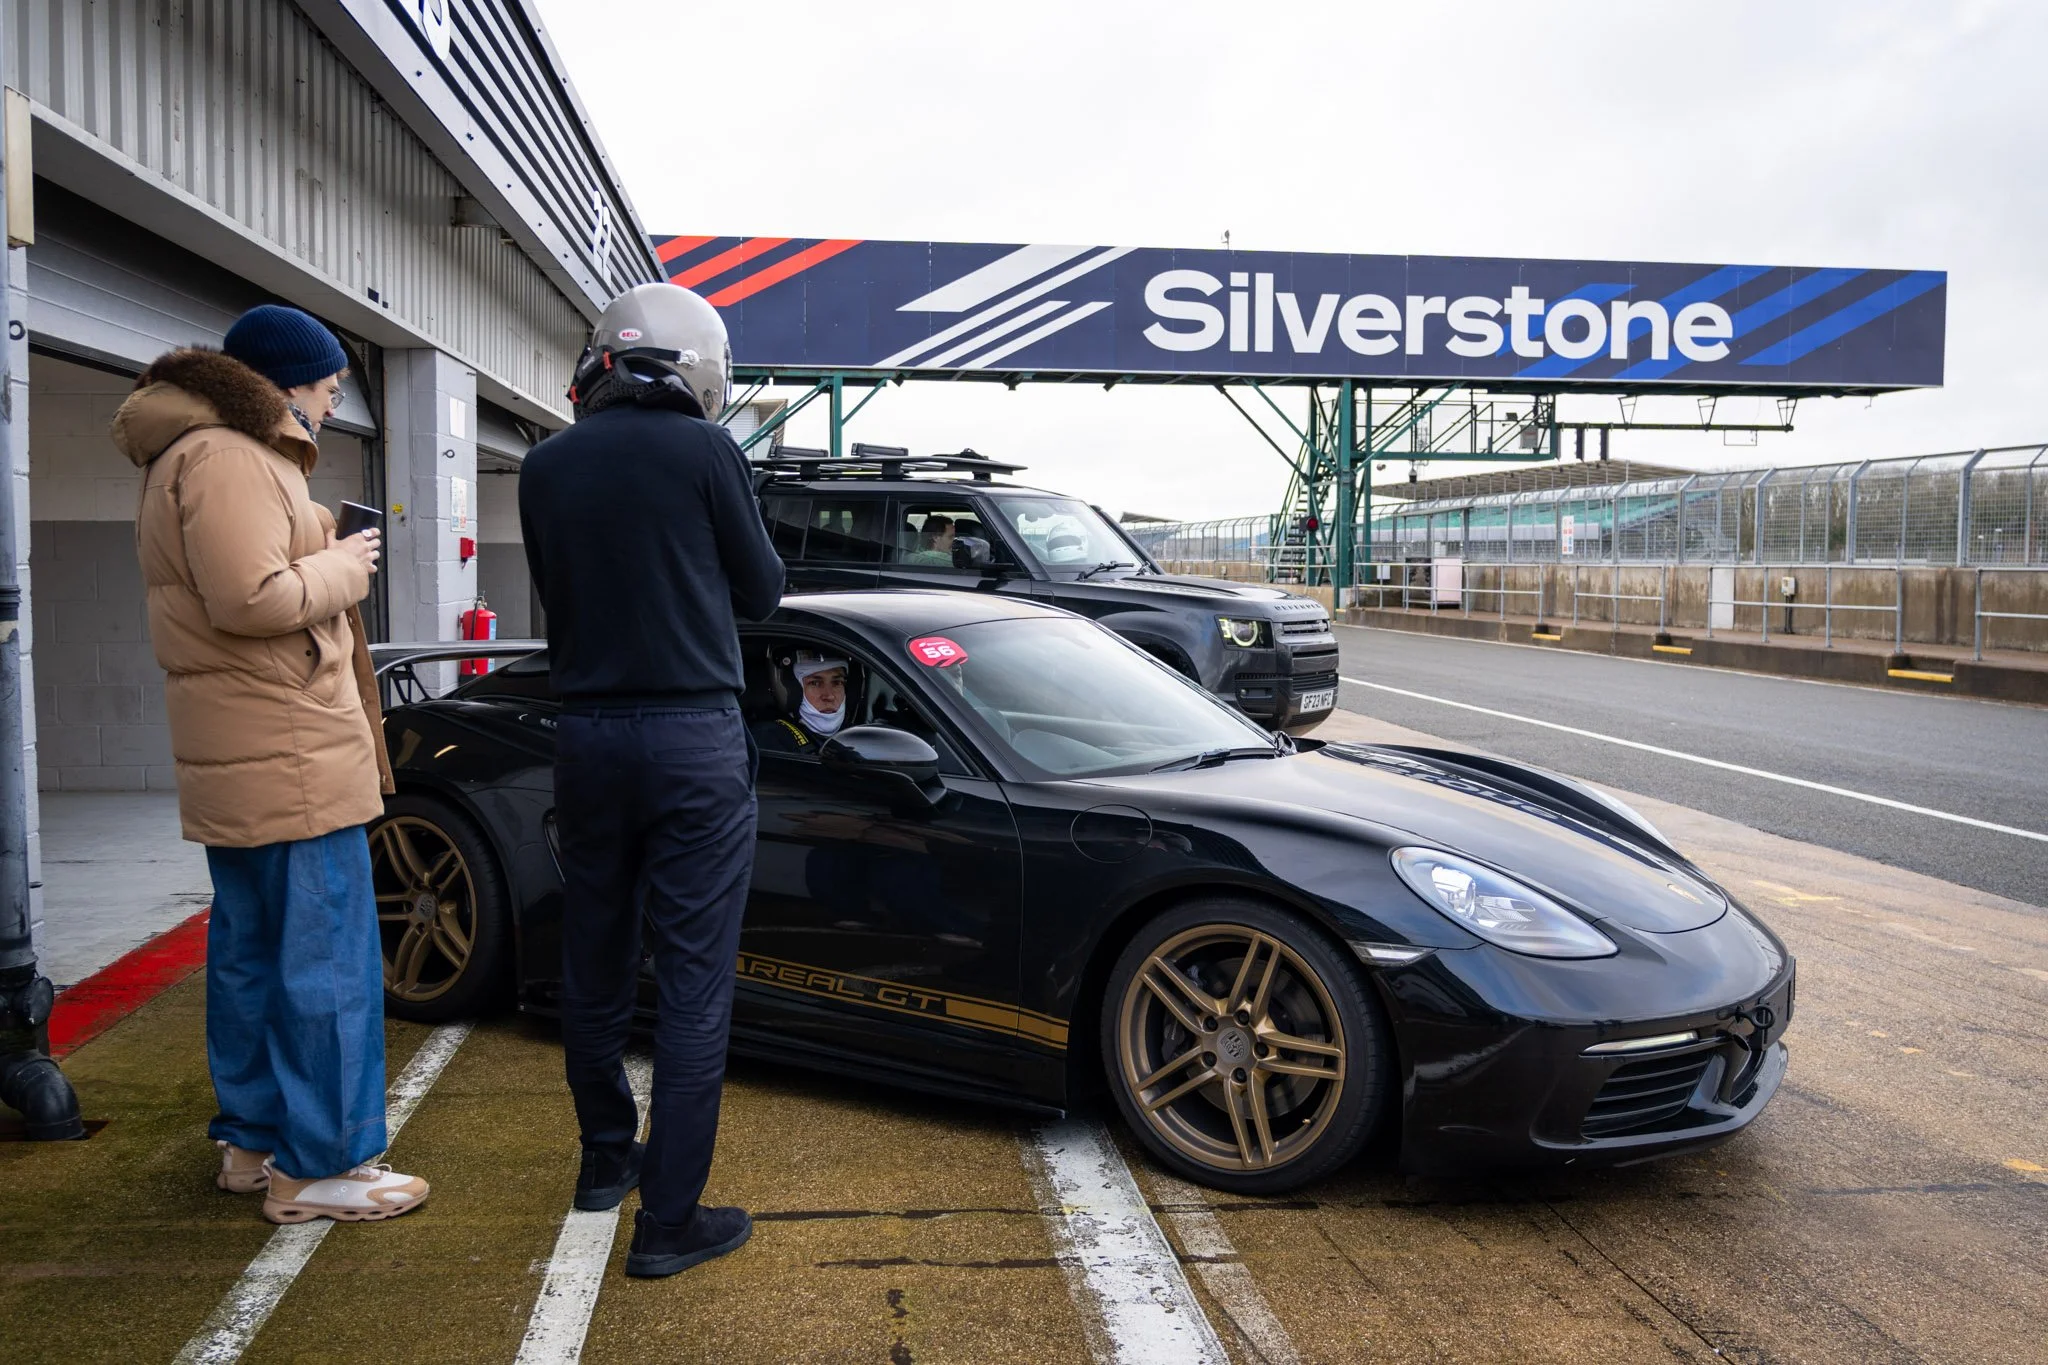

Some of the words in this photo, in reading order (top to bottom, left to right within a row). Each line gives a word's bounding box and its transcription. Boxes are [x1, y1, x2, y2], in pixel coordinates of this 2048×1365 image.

[1142, 269, 1733, 362] Silverstone
[621, 331, 640, 339] BELL
[922, 645, 956, 659] 56
[750, 960, 864, 997] REAL
[877, 987, 941, 1009] GT
